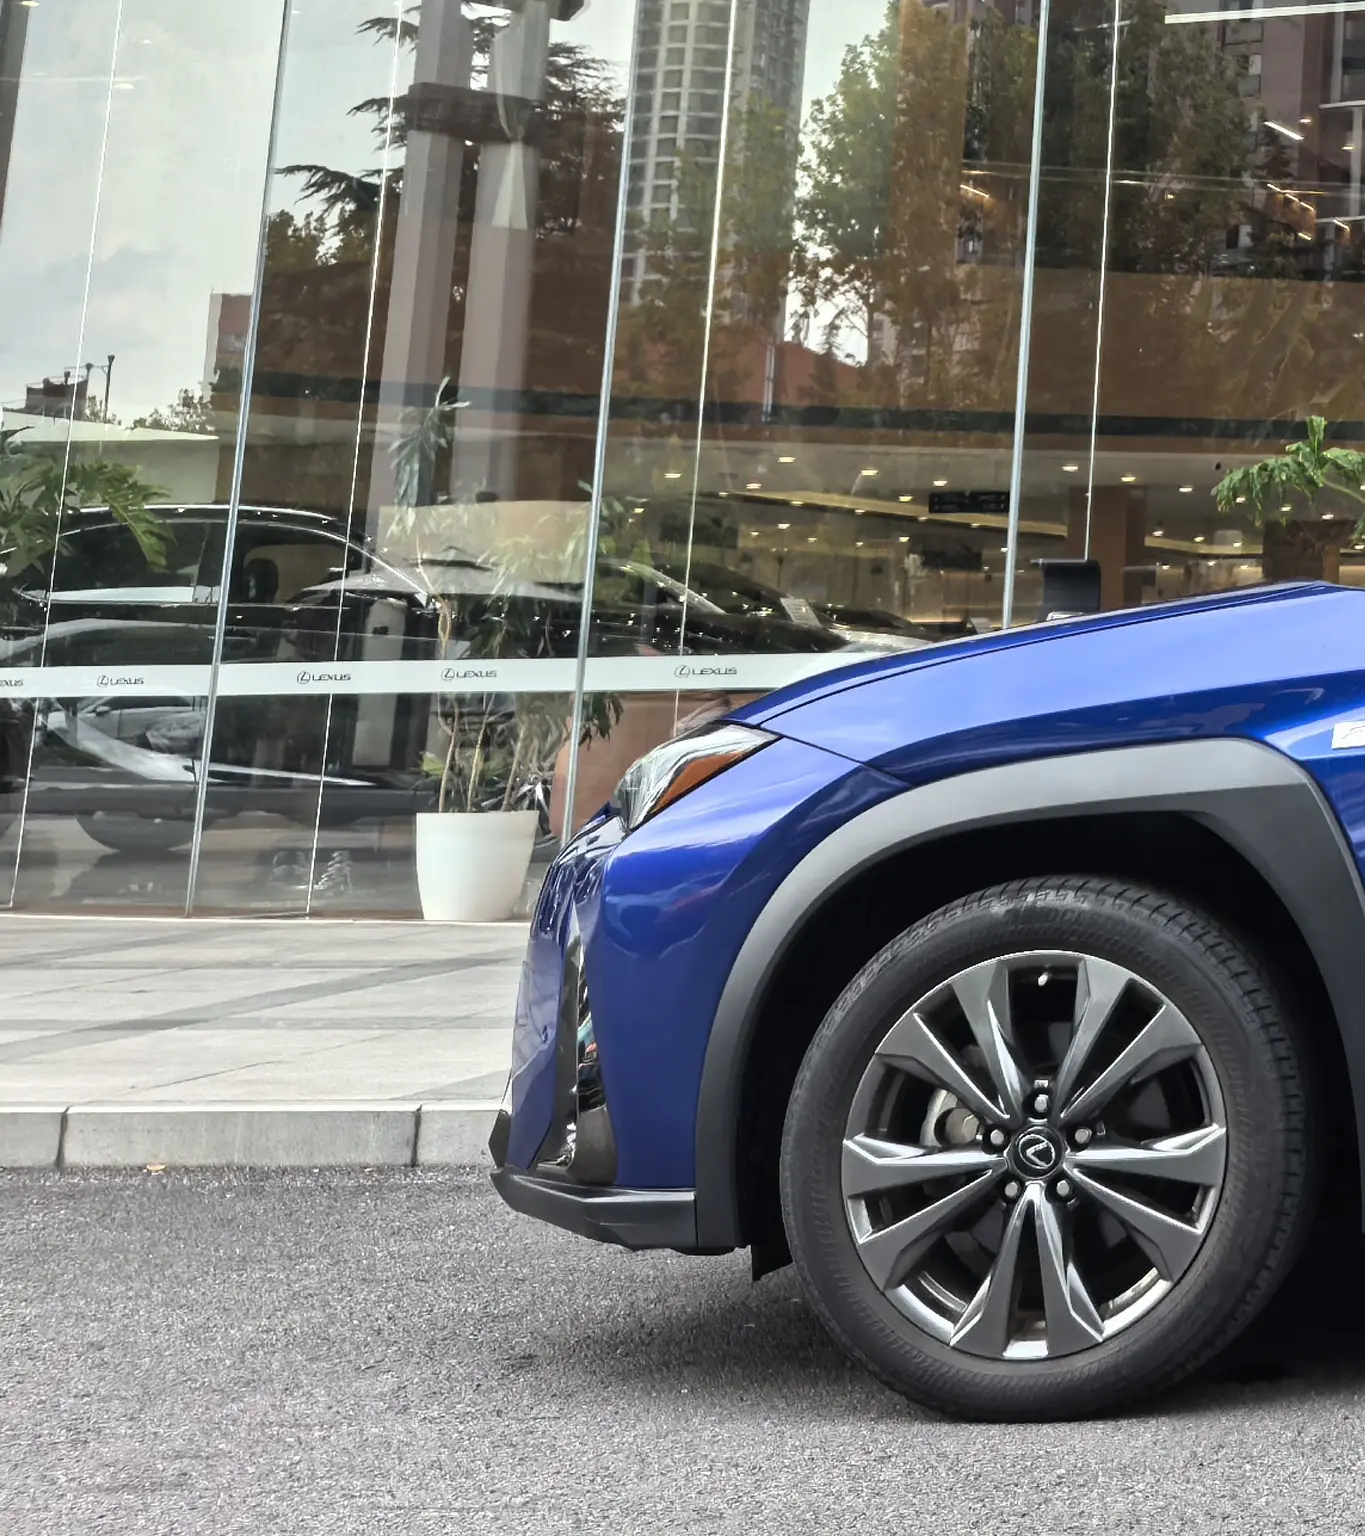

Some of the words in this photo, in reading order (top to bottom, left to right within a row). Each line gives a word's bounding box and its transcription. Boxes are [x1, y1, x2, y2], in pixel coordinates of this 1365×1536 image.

[455, 670, 498, 679] LEXUS
[691, 667, 738, 675] LEXUS
[110, 677, 145, 685] LEXUS
[312, 673, 352, 681] LEXUS
